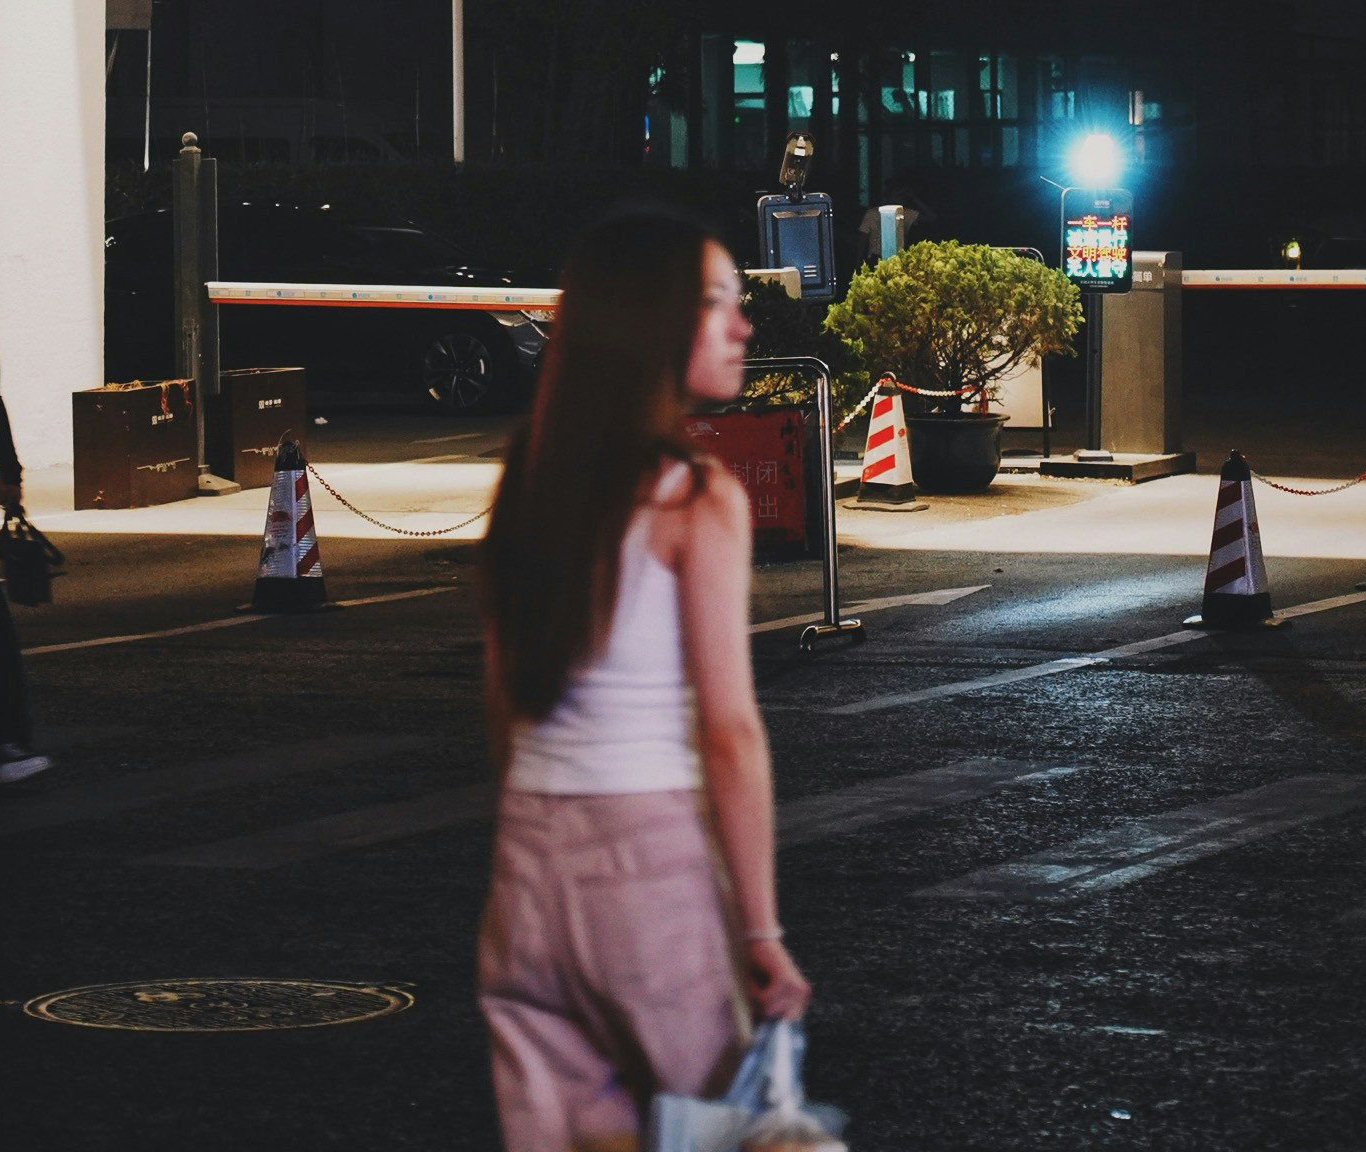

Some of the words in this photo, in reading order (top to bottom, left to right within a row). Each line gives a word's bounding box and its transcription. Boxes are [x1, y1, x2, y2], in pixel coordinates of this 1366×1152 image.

[1066, 214, 1128, 230] 一车一杆
[1066, 244, 1128, 262] 文明驾驶
